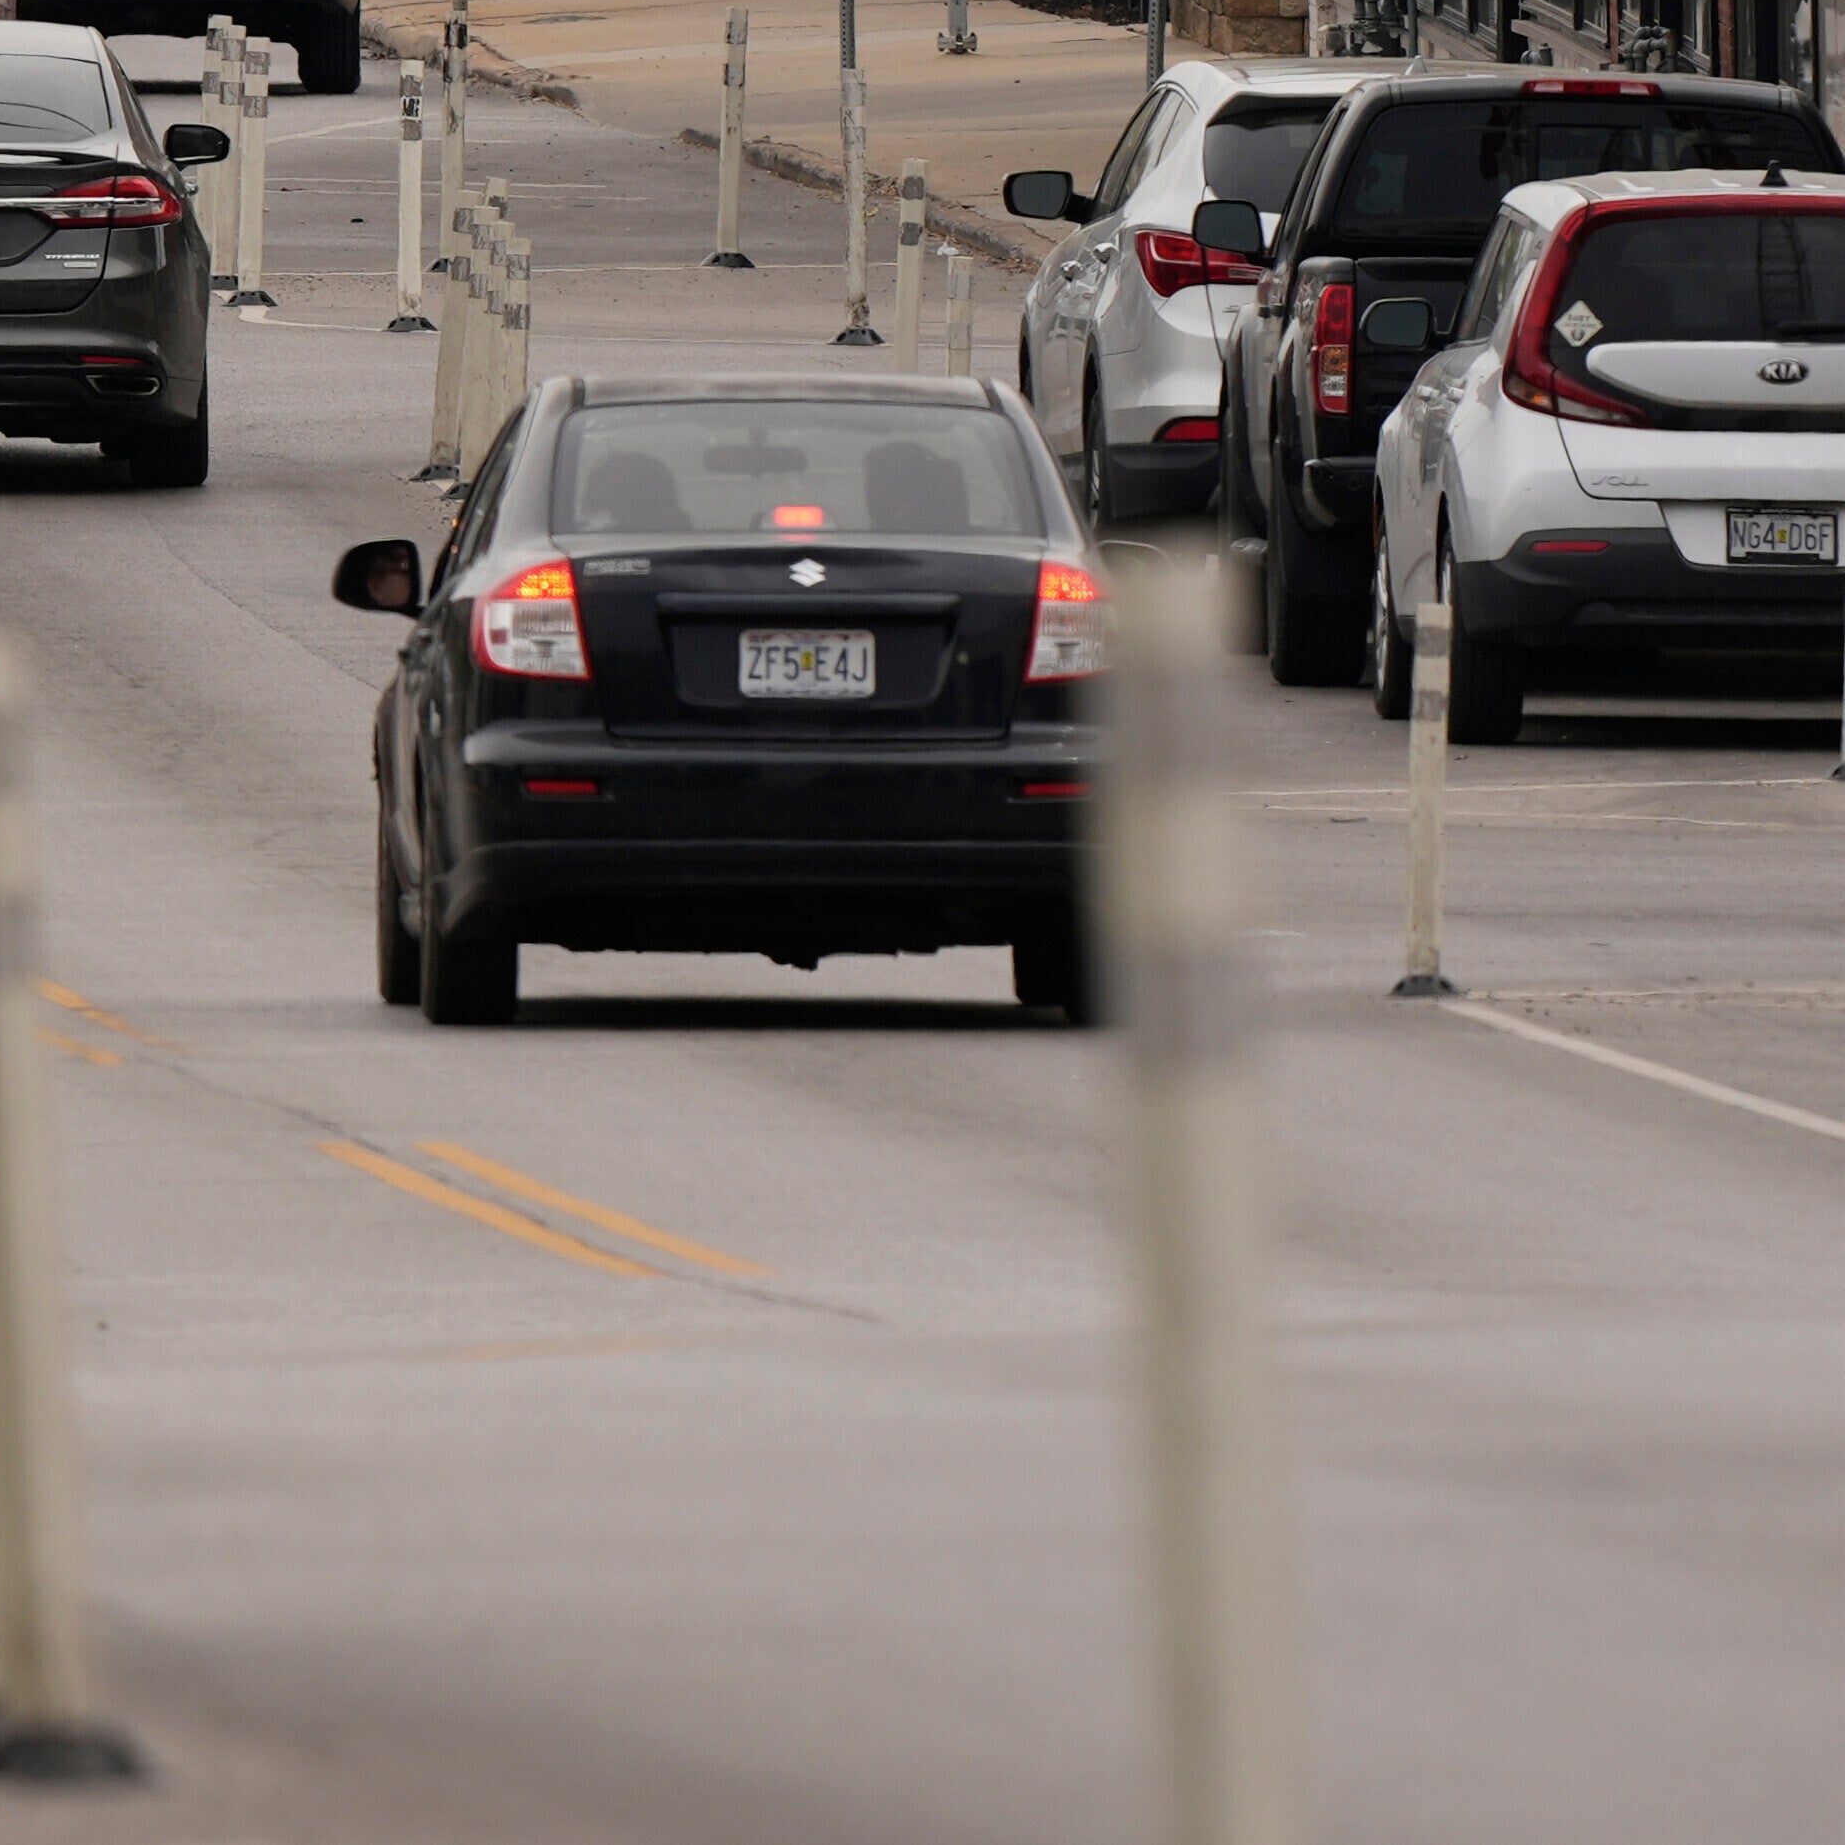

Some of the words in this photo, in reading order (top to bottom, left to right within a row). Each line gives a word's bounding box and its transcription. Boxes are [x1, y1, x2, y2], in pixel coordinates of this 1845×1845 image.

[1763, 363, 1803, 380] KIA
[1731, 522, 1776, 550] NG4
[1788, 522, 1833, 551] D6F
[747, 646, 800, 680] ZF5
[814, 646, 868, 682] E4J
